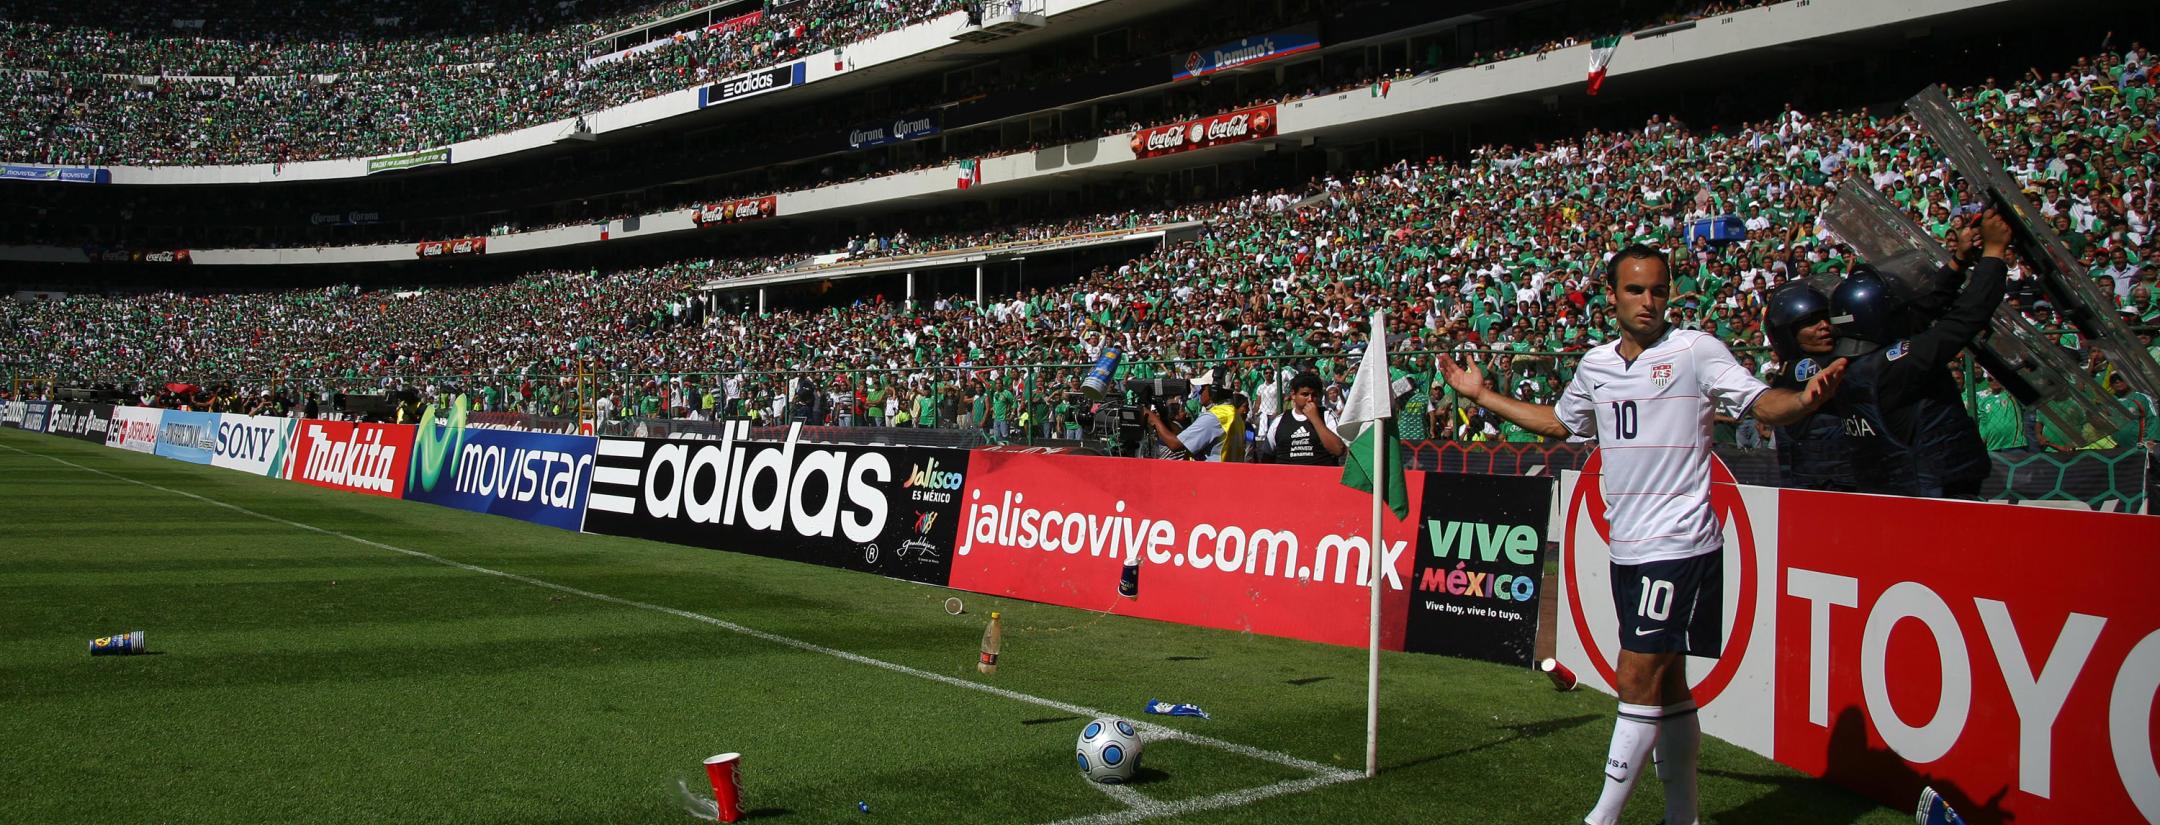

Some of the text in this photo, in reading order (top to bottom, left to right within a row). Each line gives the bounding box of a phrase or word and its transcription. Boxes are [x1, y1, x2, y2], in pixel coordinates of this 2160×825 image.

[1214, 37, 1275, 68] Domino's
[734, 73, 773, 95] adidas
[849, 128, 884, 149] Corona
[893, 118, 930, 140] Corona
[1147, 125, 1185, 150] Coca-Cola
[1207, 113, 1250, 140] Coca-Cola
[1612, 401, 1637, 440] 10
[215, 421, 274, 464] SONY
[455, 443, 592, 510] movistar
[644, 417, 892, 543] adidas
[904, 456, 962, 490] Jalisco
[912, 490, 951, 503] ES MÉXICO
[958, 488, 1408, 591] jaliscovive.com.mx
[1425, 600, 1522, 621] Vive hoy, vive lo tuyo.
[1637, 575, 1675, 622] 10
[1608, 757, 1628, 770] USA
